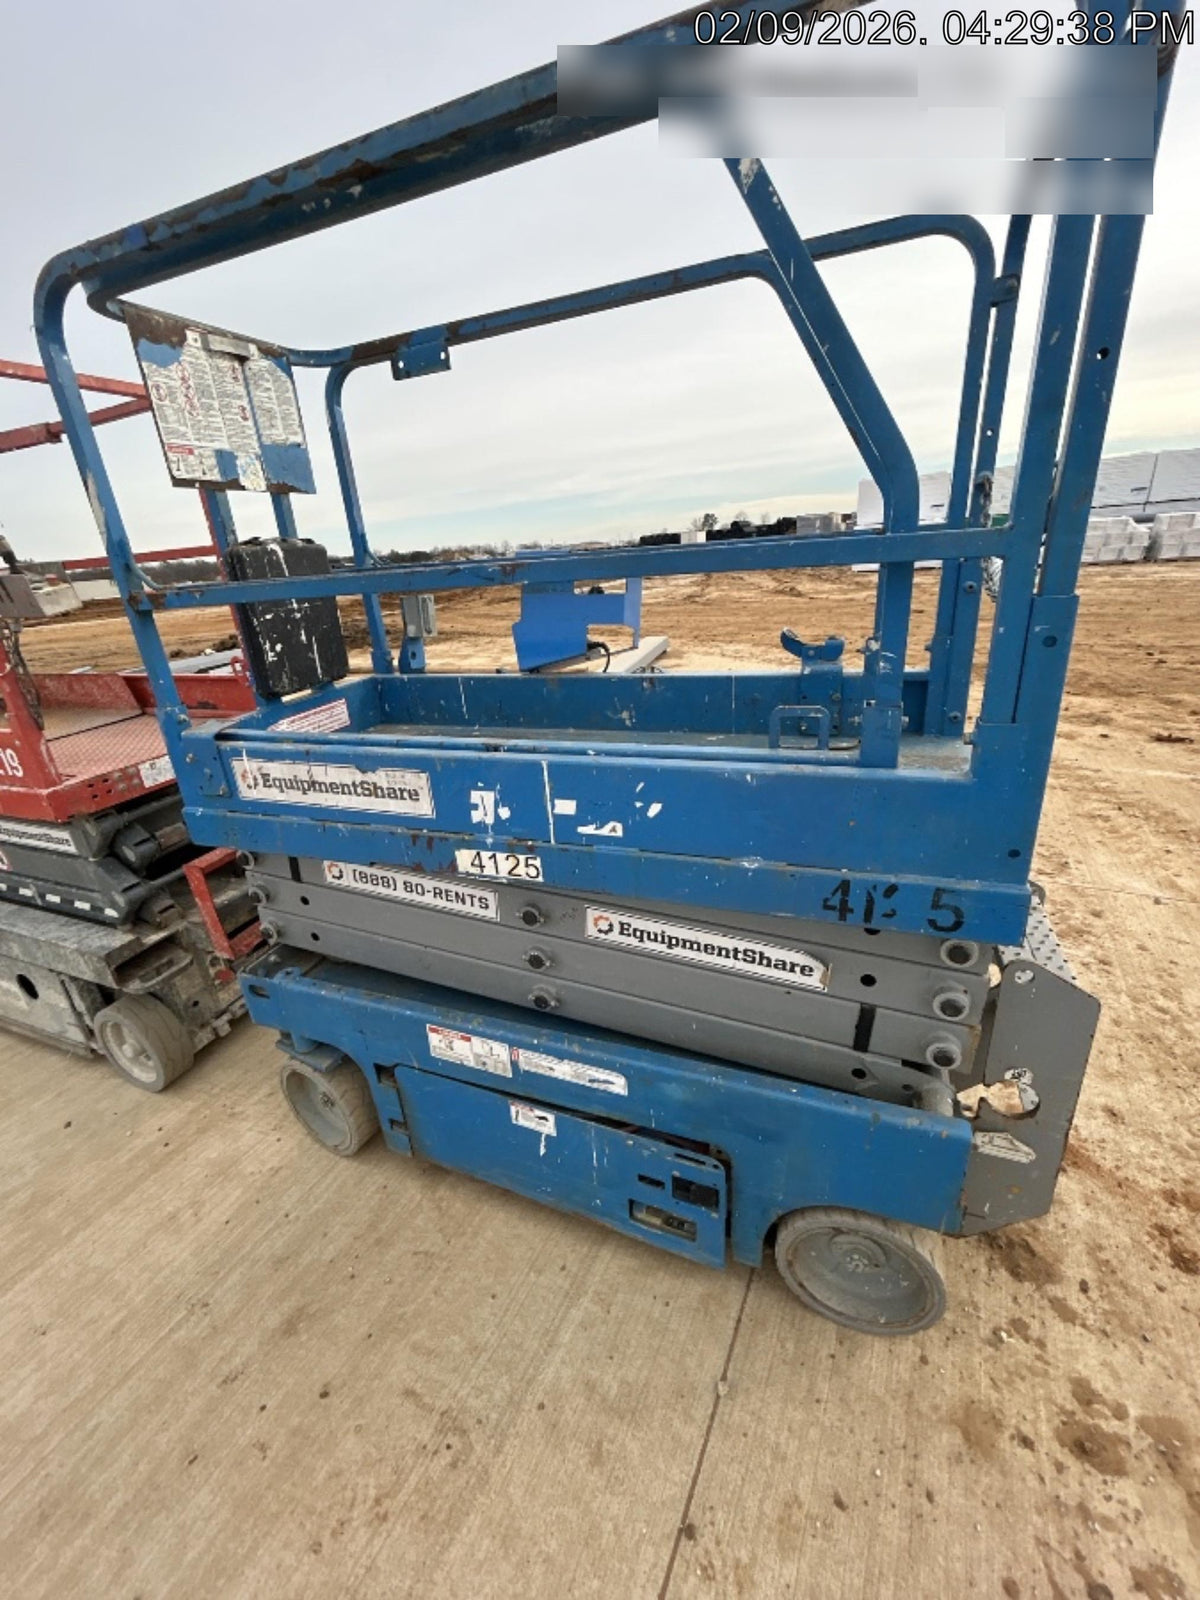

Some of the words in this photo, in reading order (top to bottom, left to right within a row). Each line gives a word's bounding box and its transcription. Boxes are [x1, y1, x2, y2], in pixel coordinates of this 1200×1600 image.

[260, 772, 420, 802] EquipmentShare
[470, 851, 541, 880] 4125
[352, 868, 397, 891] (888)
[402, 879, 490, 910] 80-RENTS
[617, 919, 816, 979] EquipmentShare
